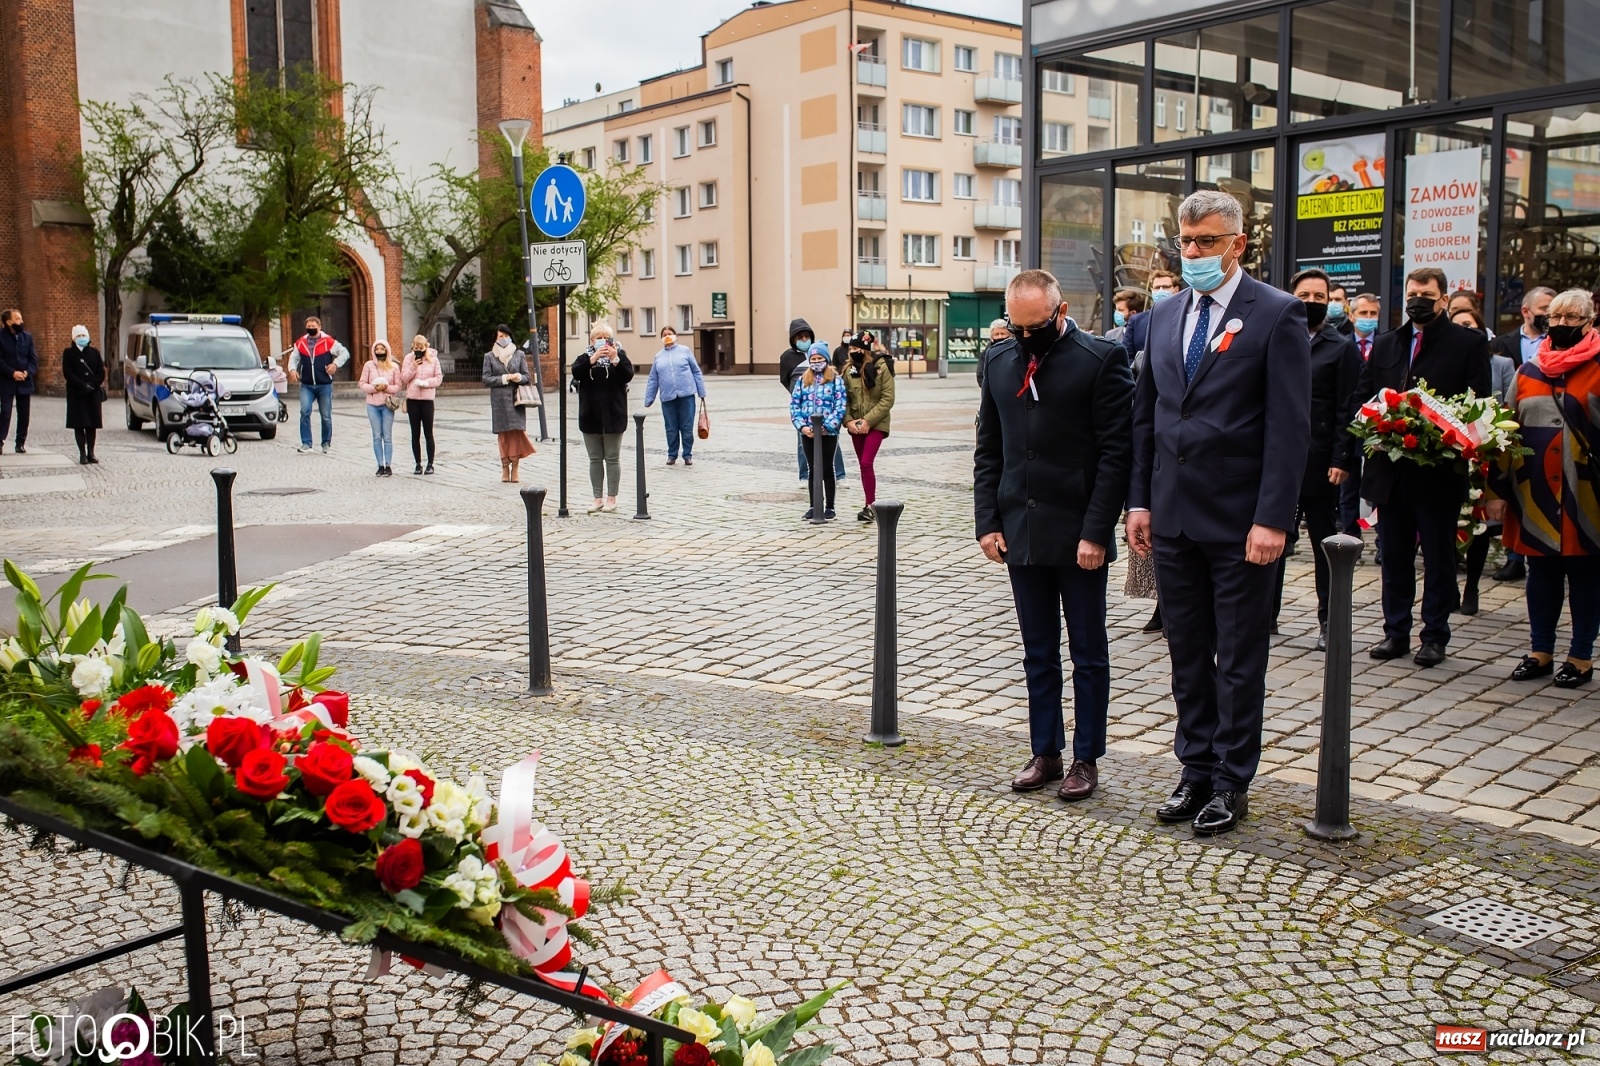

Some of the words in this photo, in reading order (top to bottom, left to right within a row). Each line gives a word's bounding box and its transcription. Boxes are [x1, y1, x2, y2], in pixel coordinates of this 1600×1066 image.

[1411, 179, 1478, 204] ZAMÓW
[1300, 196, 1334, 216] CATERING
[1335, 192, 1384, 213] DIETETYCZNY
[1412, 210, 1418, 220] Z
[1421, 205, 1475, 219] DOWOZEM
[1333, 220, 1347, 232] BEZ
[1348, 217, 1383, 231] PSZENICY
[1431, 222, 1452, 232] LUB
[1415, 235, 1471, 249] ODBIOREM
[533, 246, 547, 255] Nie
[550, 245, 582, 256] dotyczy
[1414, 253, 1423, 263] W
[1426, 250, 1470, 262] LOKALU
[859, 301, 921, 320] STELLA
